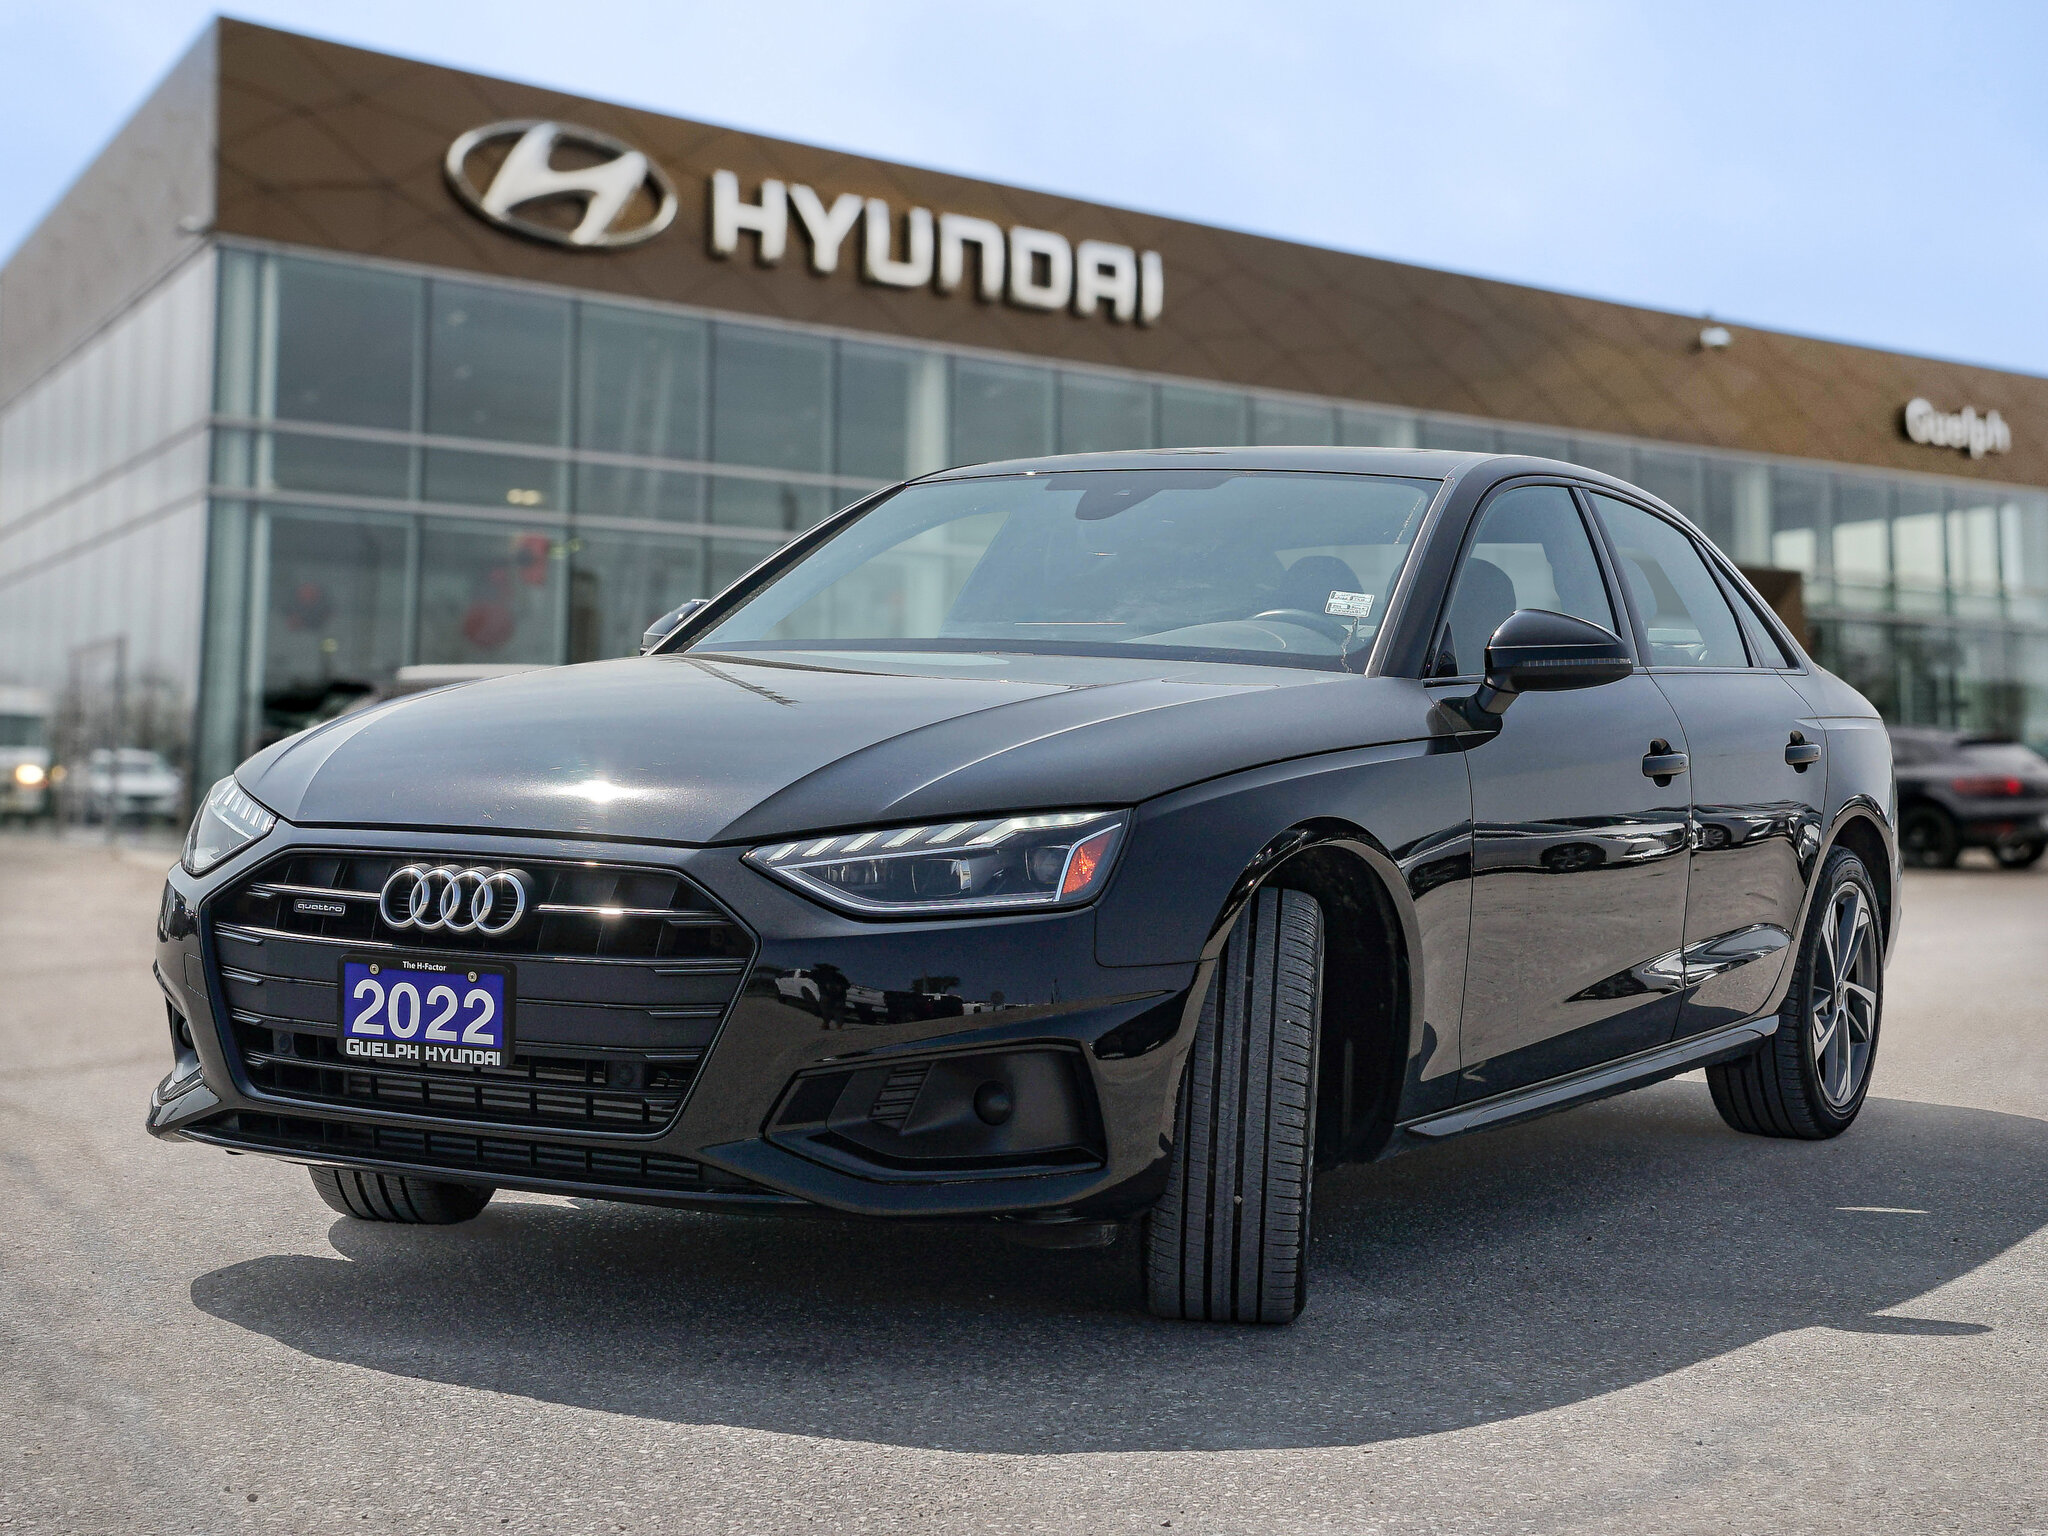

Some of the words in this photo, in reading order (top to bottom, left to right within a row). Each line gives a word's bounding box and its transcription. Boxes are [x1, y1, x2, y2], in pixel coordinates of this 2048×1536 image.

[709, 168, 1165, 326] HYUNDAI
[1904, 397, 2011, 460] Guelph
[297, 903, 343, 912] quattro
[402, 960, 416, 970] The
[416, 961, 447, 972] H-Factor
[351, 978, 496, 1046] 2022
[345, 1038, 420, 1060] GUELPH
[425, 1045, 501, 1067] HYUNDAI
